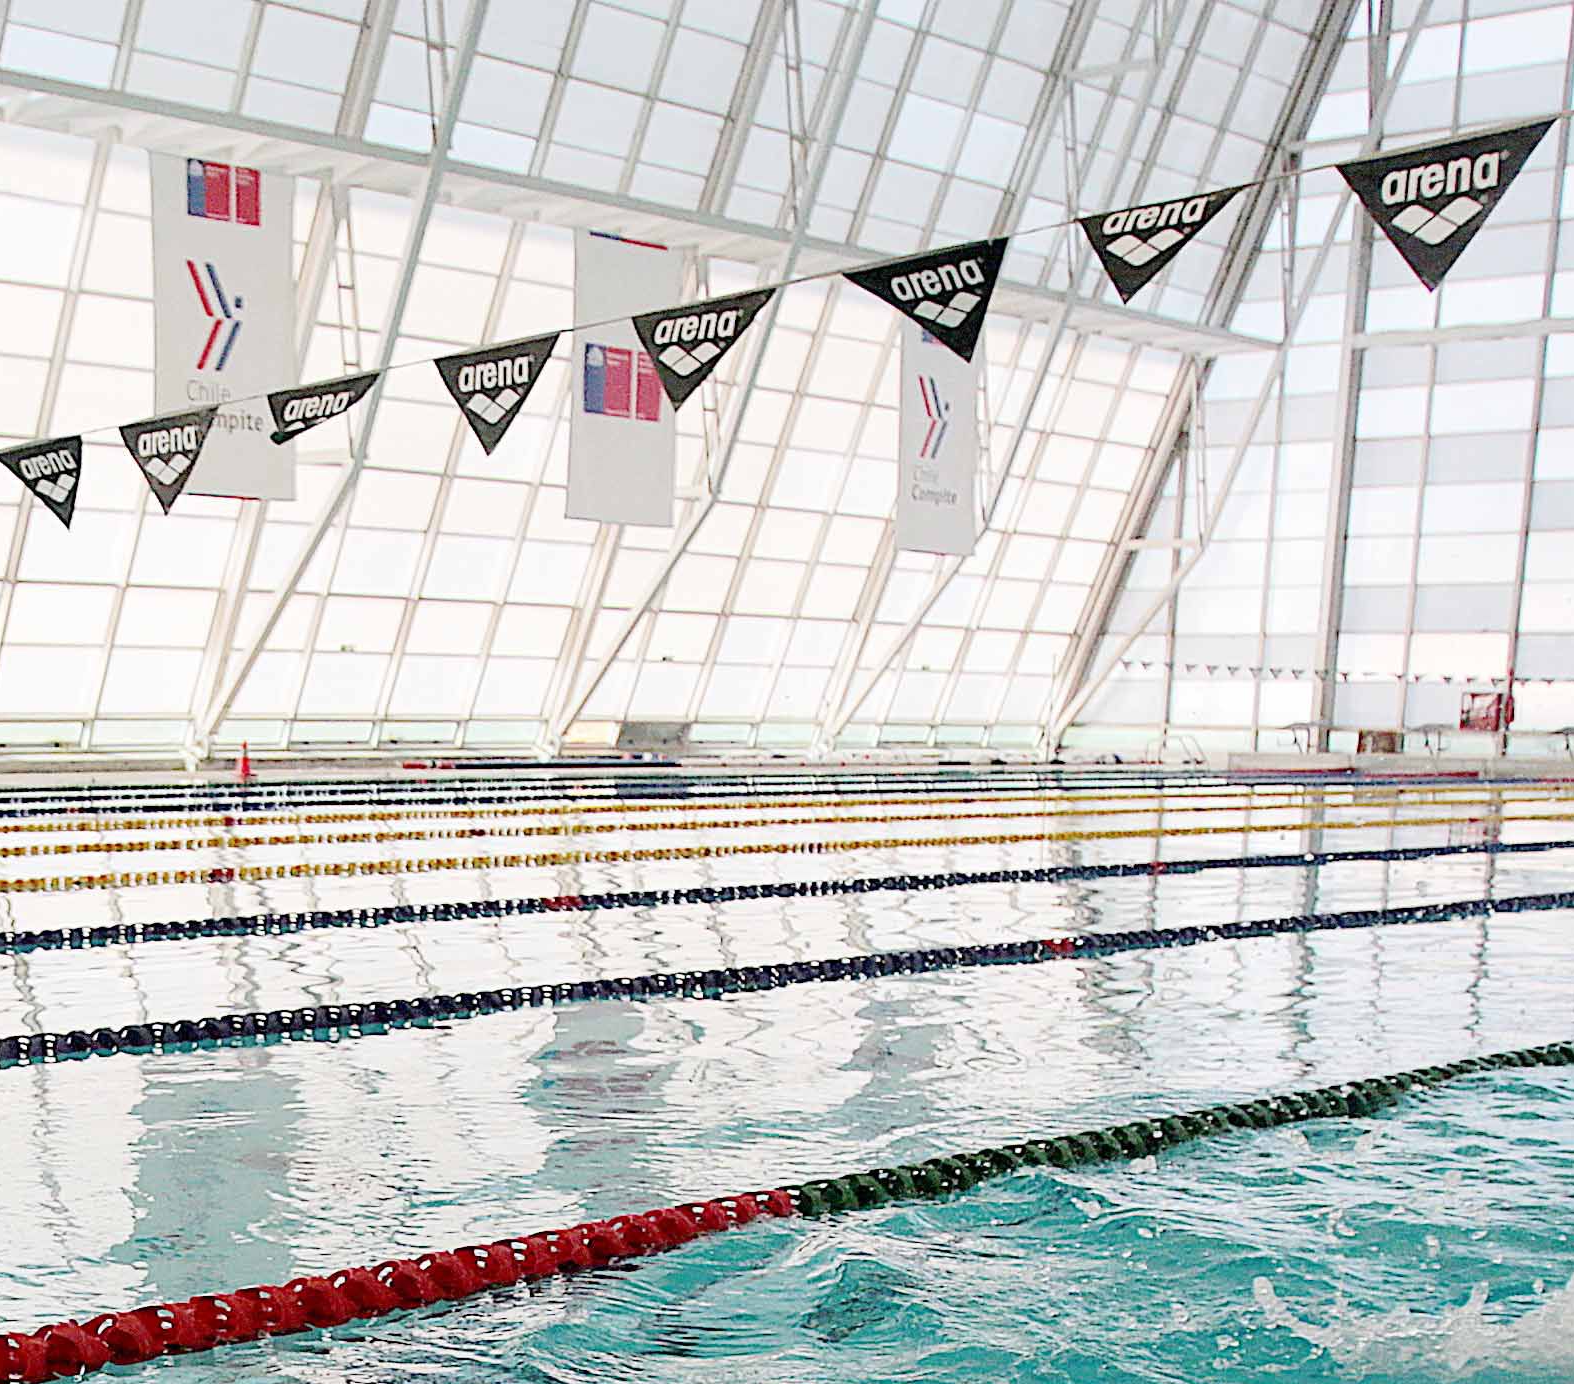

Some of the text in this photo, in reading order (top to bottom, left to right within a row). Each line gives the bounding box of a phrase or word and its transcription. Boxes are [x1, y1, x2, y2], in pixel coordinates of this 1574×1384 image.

[1380, 151, 1501, 206] arena
[1102, 195, 1208, 236] arena
[890, 257, 985, 302] arena
[653, 309, 738, 344] arena
[186, 379, 231, 402] Chile
[457, 355, 531, 394] arena
[283, 390, 351, 422] arena
[137, 426, 198, 458] arena
[19, 449, 77, 480] arena
